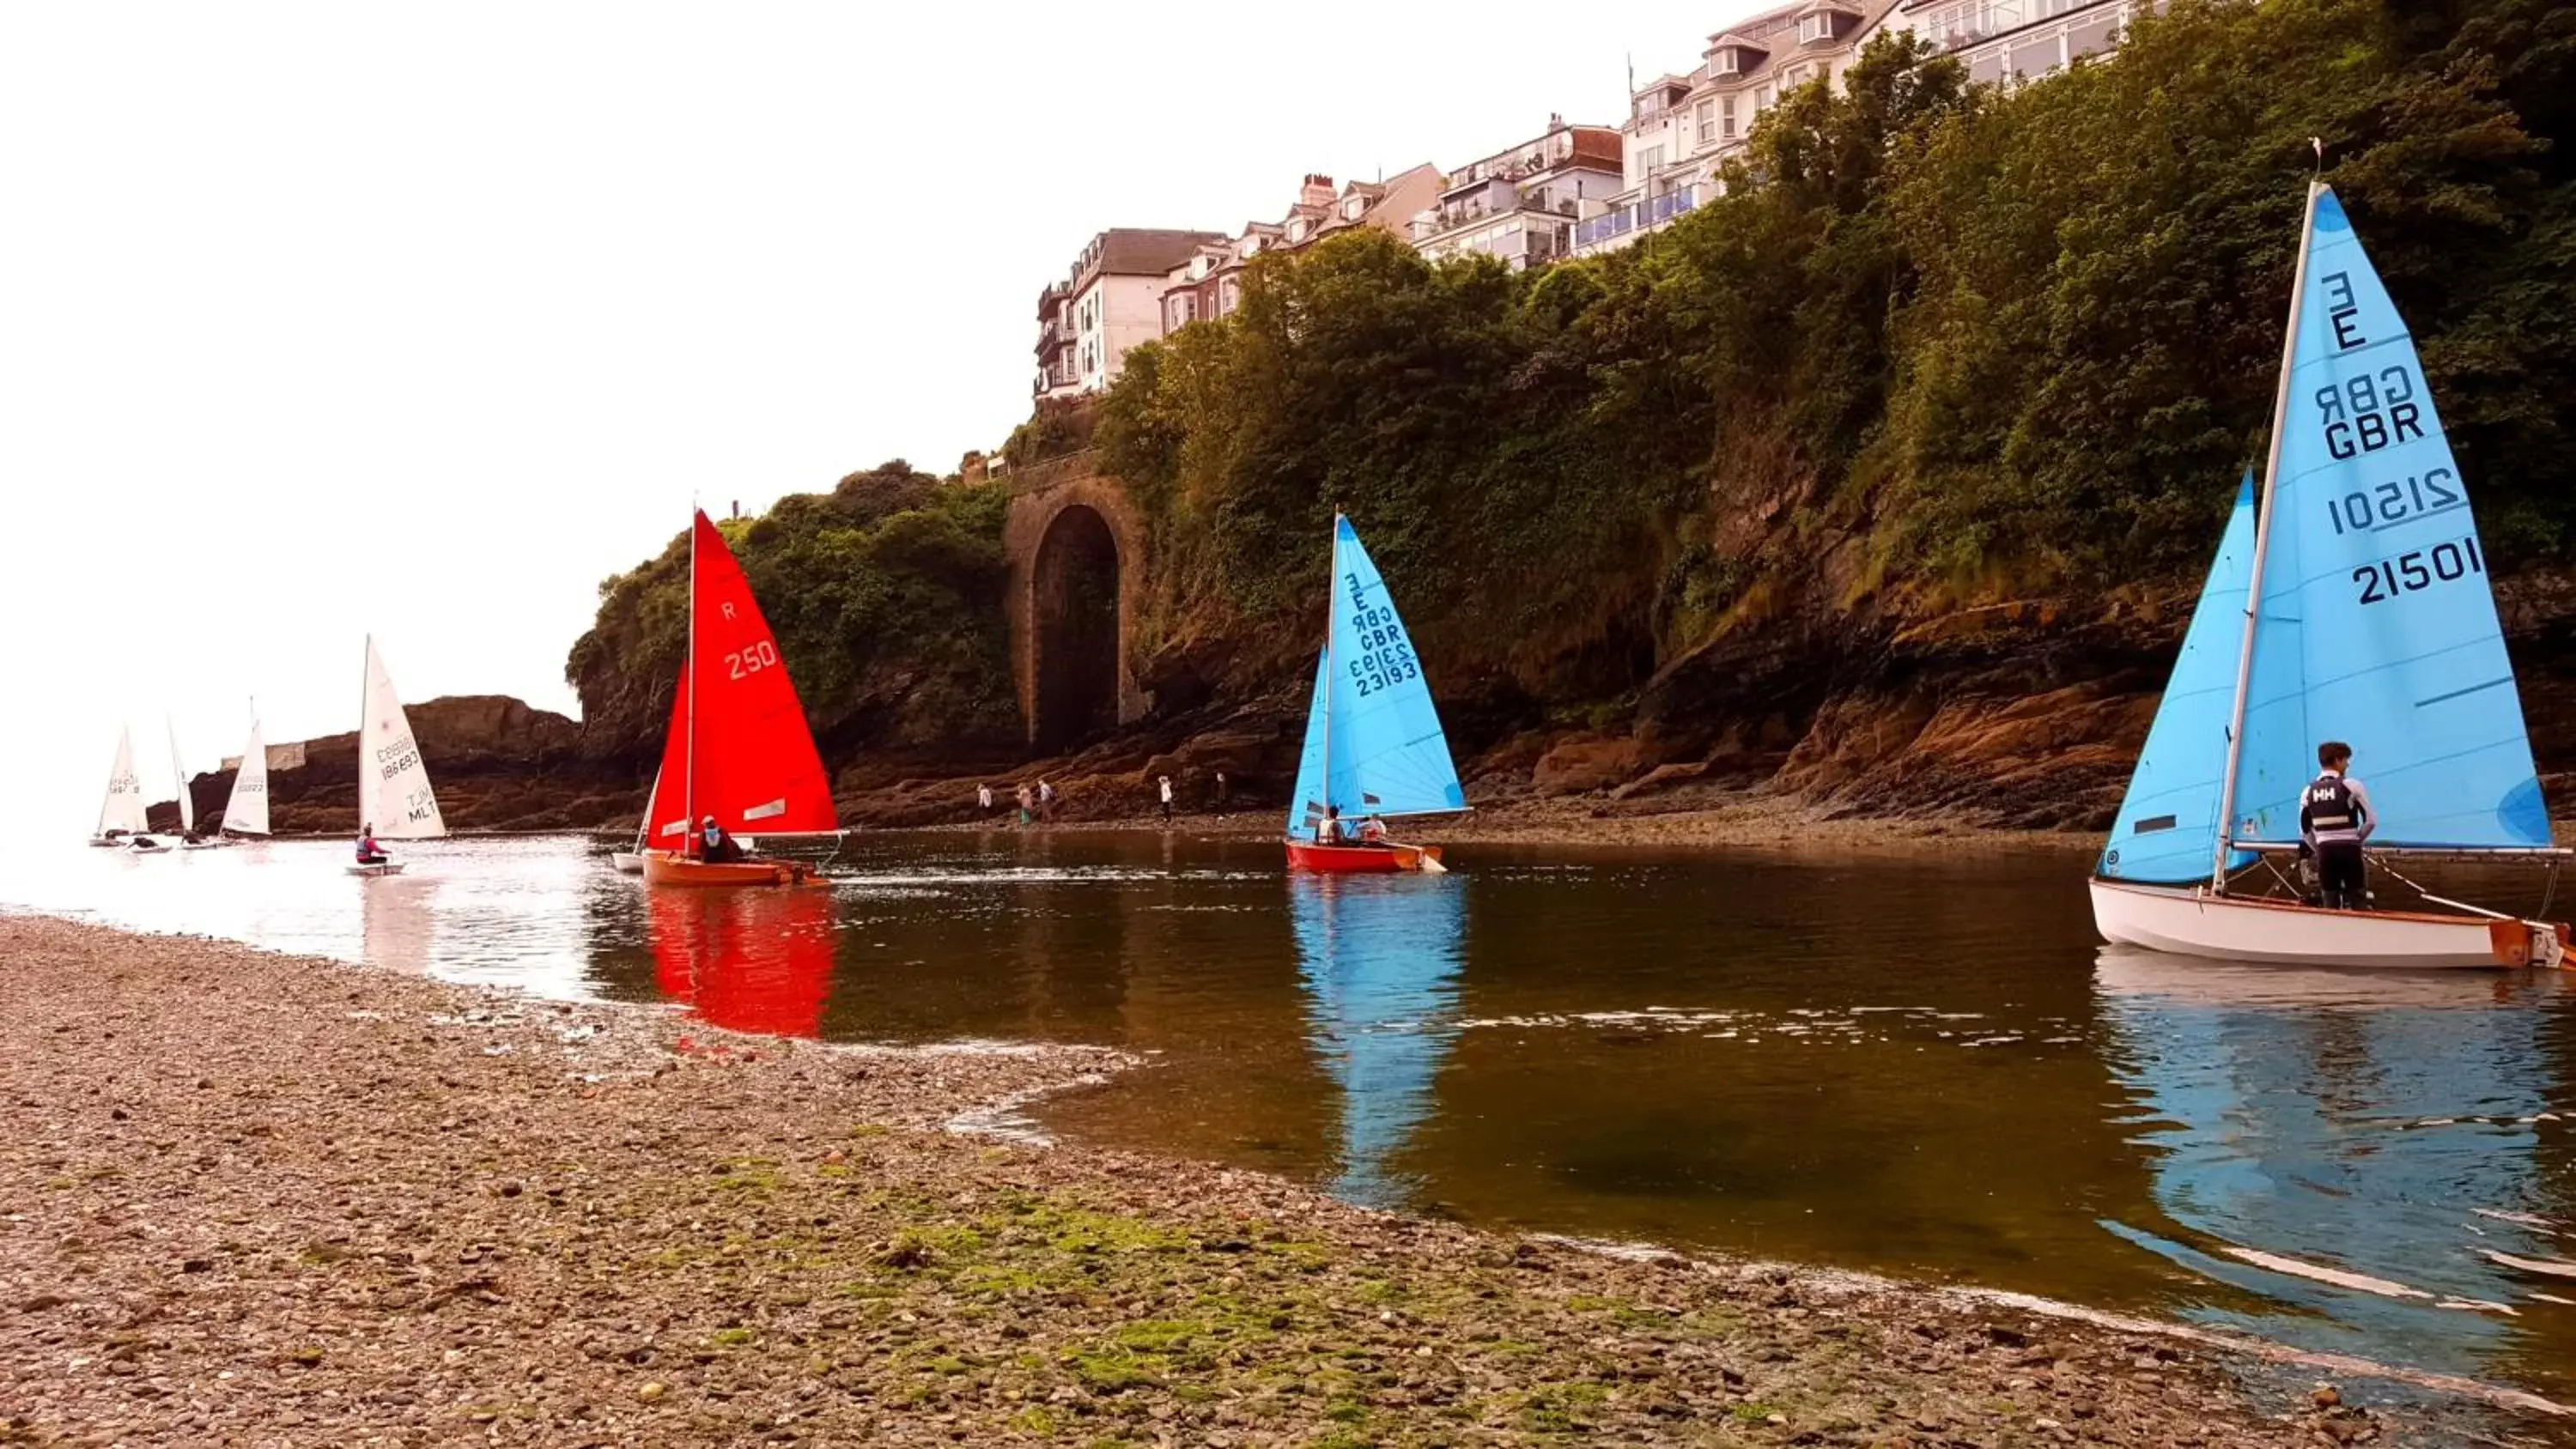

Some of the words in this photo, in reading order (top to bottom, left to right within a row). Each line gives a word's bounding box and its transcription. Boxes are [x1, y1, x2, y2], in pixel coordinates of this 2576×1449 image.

[2331, 308, 2366, 350] E
[2325, 403, 2425, 460] GBR
[2353, 537, 2481, 604] 21501
[720, 602, 737, 621] R
[1353, 591, 1369, 612] E
[1361, 624, 1400, 651] GBR
[725, 640, 776, 680] 250
[1357, 662, 1417, 697] 23193
[2312, 787, 2336, 803] HH
